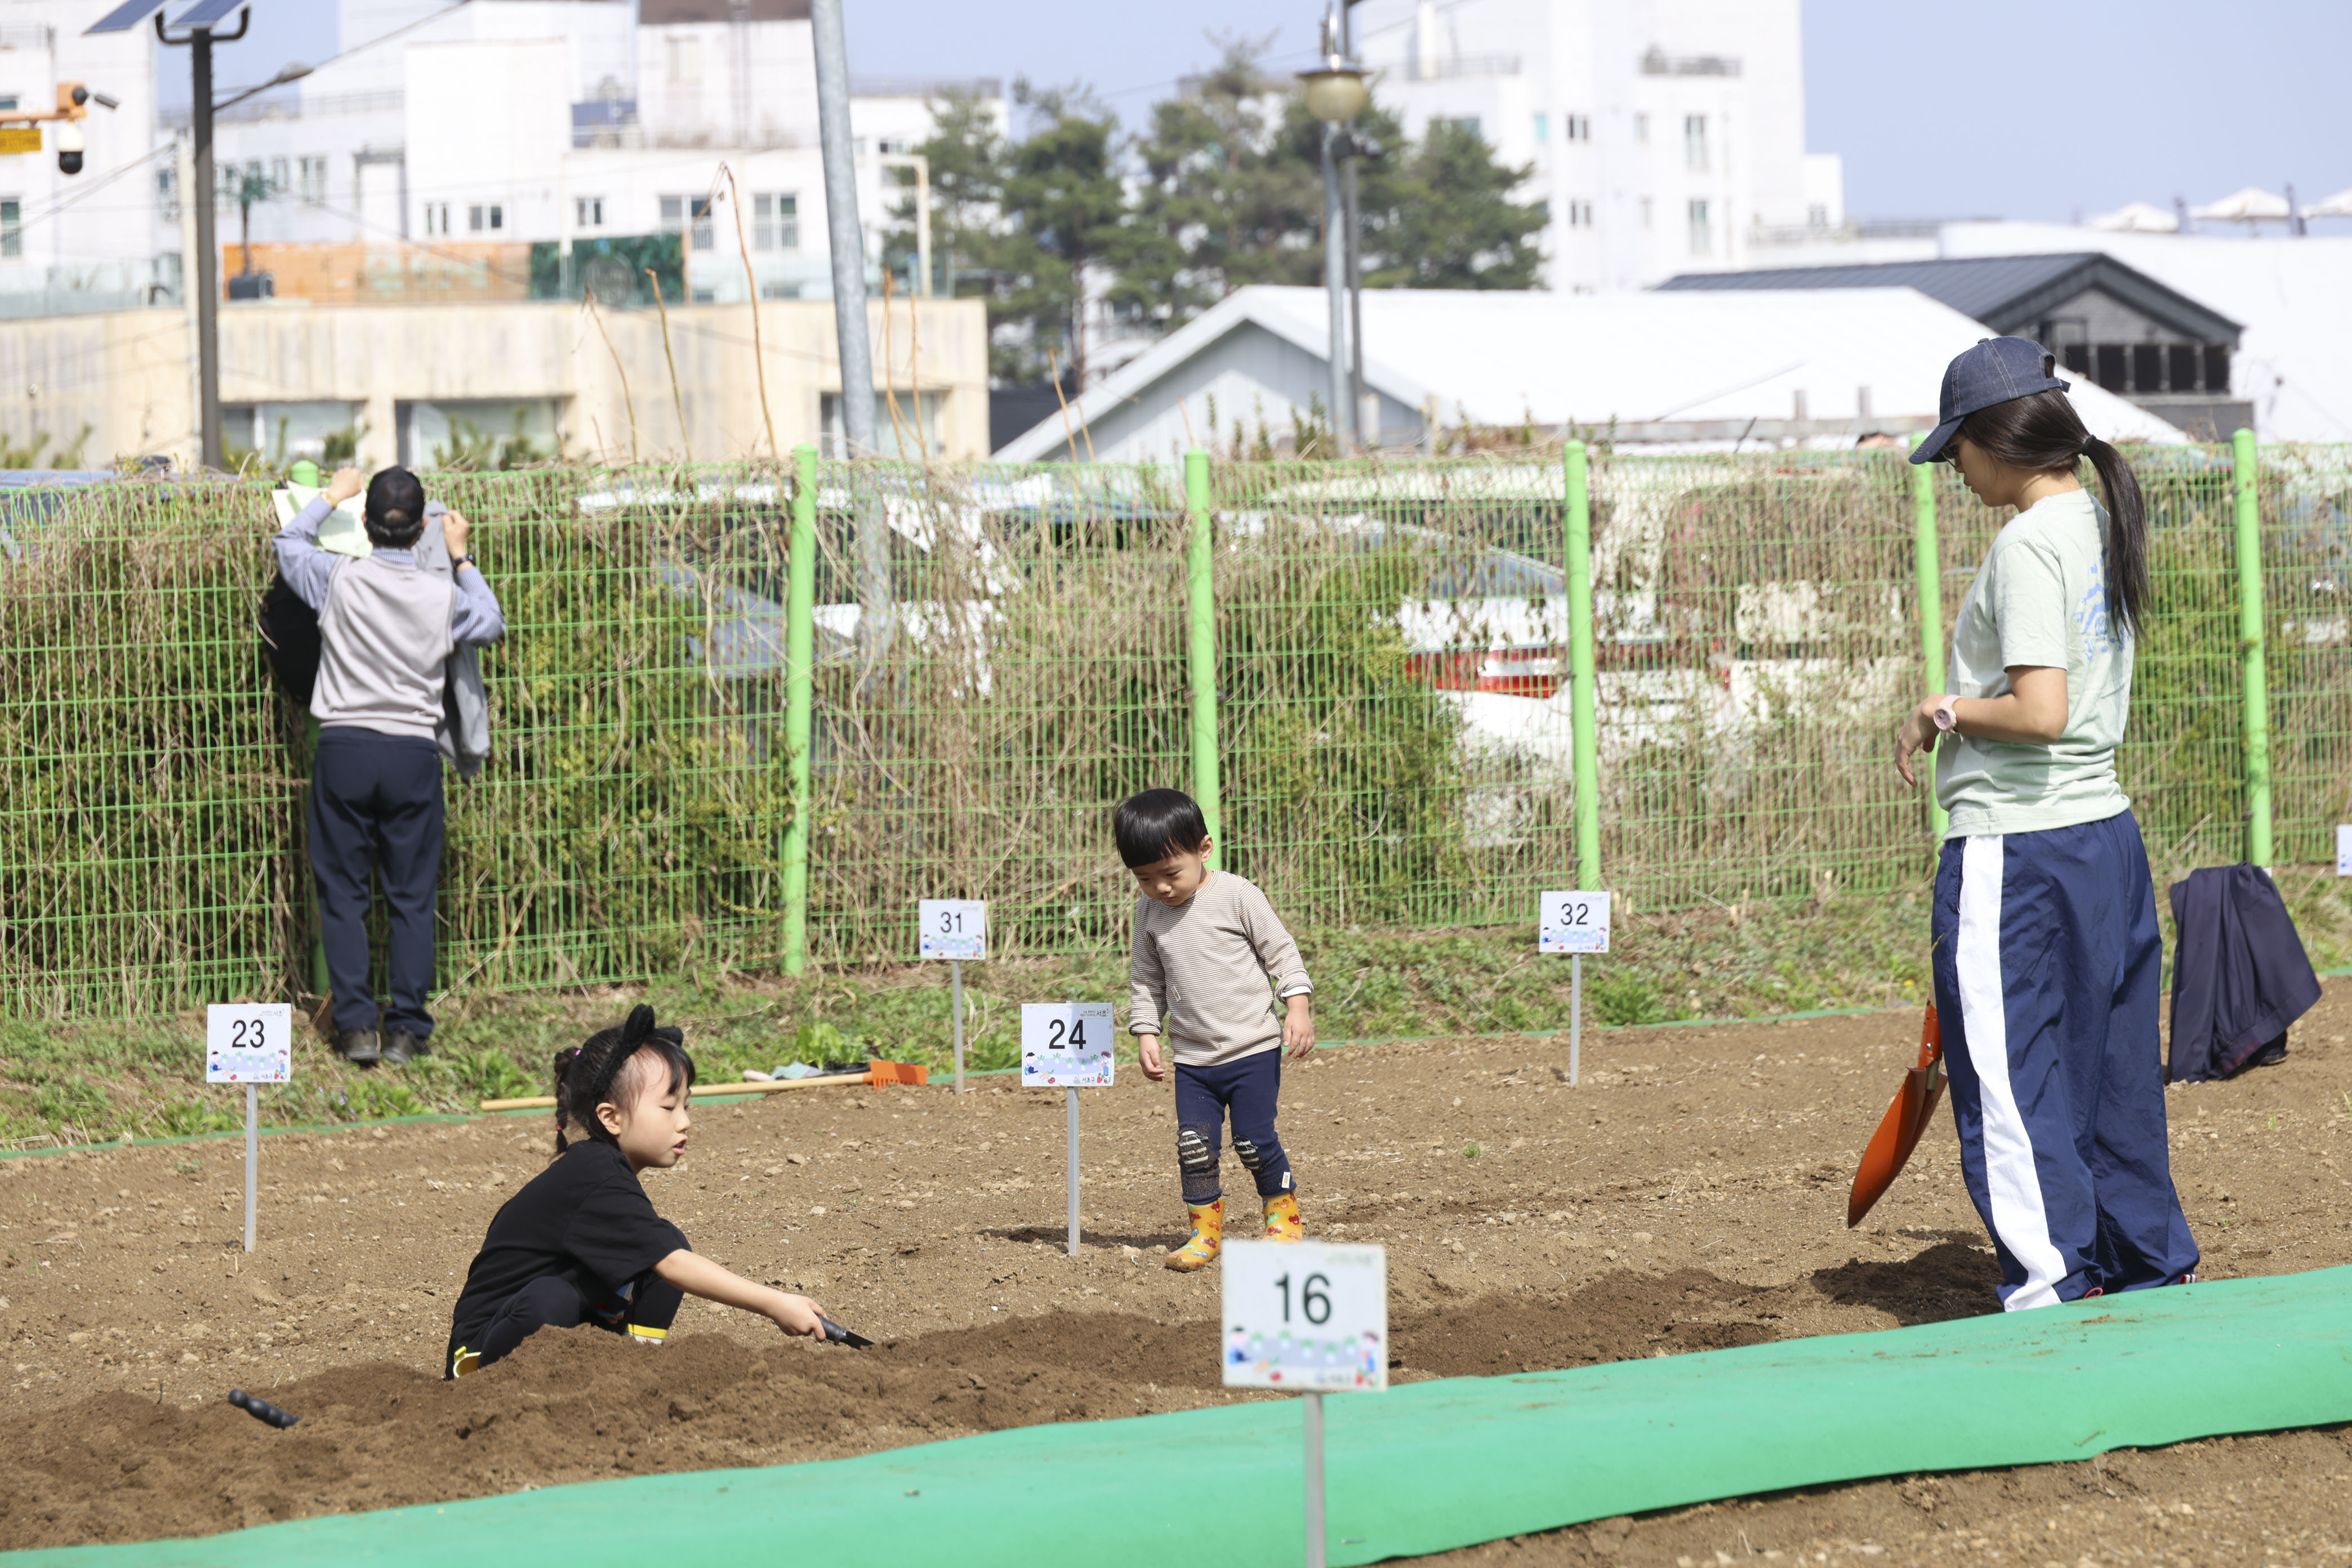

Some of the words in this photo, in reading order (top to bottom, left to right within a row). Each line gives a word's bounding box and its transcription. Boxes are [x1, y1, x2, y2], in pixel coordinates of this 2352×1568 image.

[940, 911, 961, 933] 31
[1561, 902, 1588, 925] 32
[231, 1019, 265, 1048] 23
[1049, 1019, 1086, 1050] 24
[1275, 1272, 1331, 1325] 16
